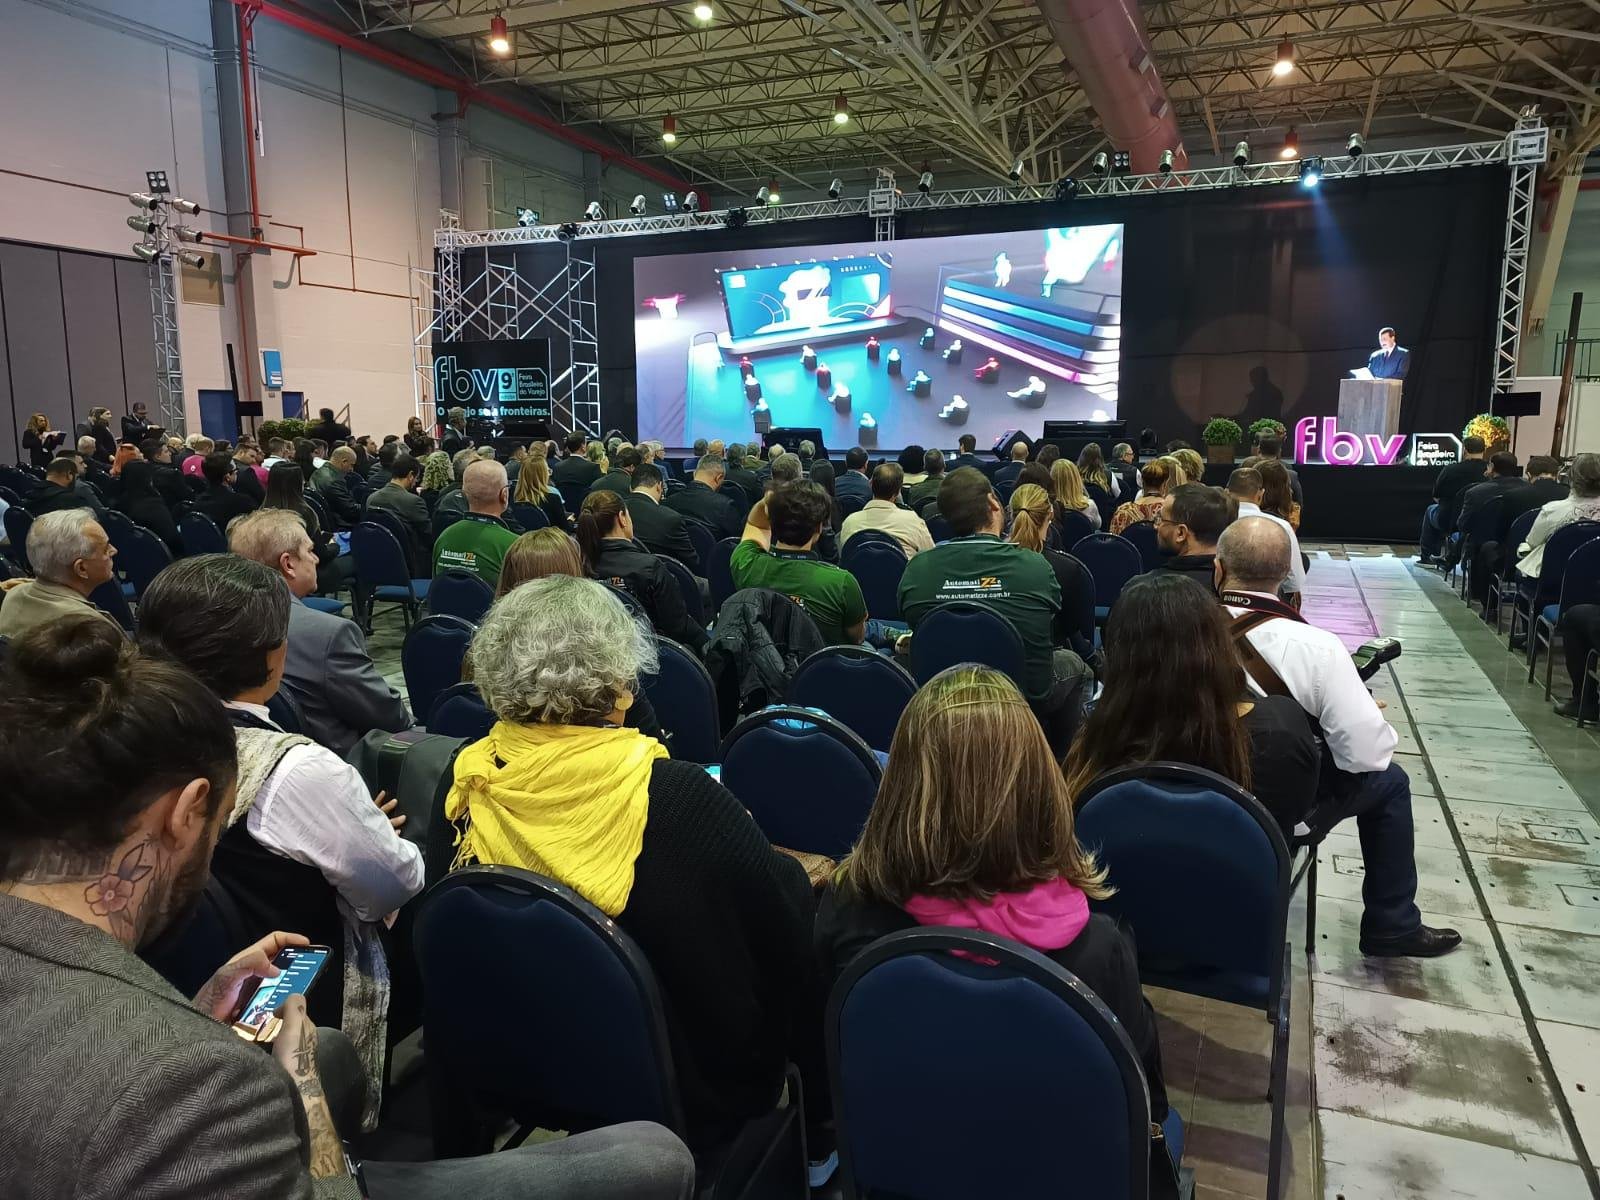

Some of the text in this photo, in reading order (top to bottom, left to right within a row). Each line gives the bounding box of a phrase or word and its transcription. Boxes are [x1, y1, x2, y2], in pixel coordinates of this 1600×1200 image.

[434, 356, 498, 402] fbv
[527, 388, 546, 397] Varejo
[500, 406, 551, 416] fronteiras.
[1294, 416, 1407, 465] fbv
[1417, 441, 1439, 450] Feira
[1417, 450, 1456, 458] Brasileira
[1416, 457, 1429, 466] do
[935, 591, 1010, 599] www.automatizze.com.br
[1224, 595, 1251, 605] Canon
